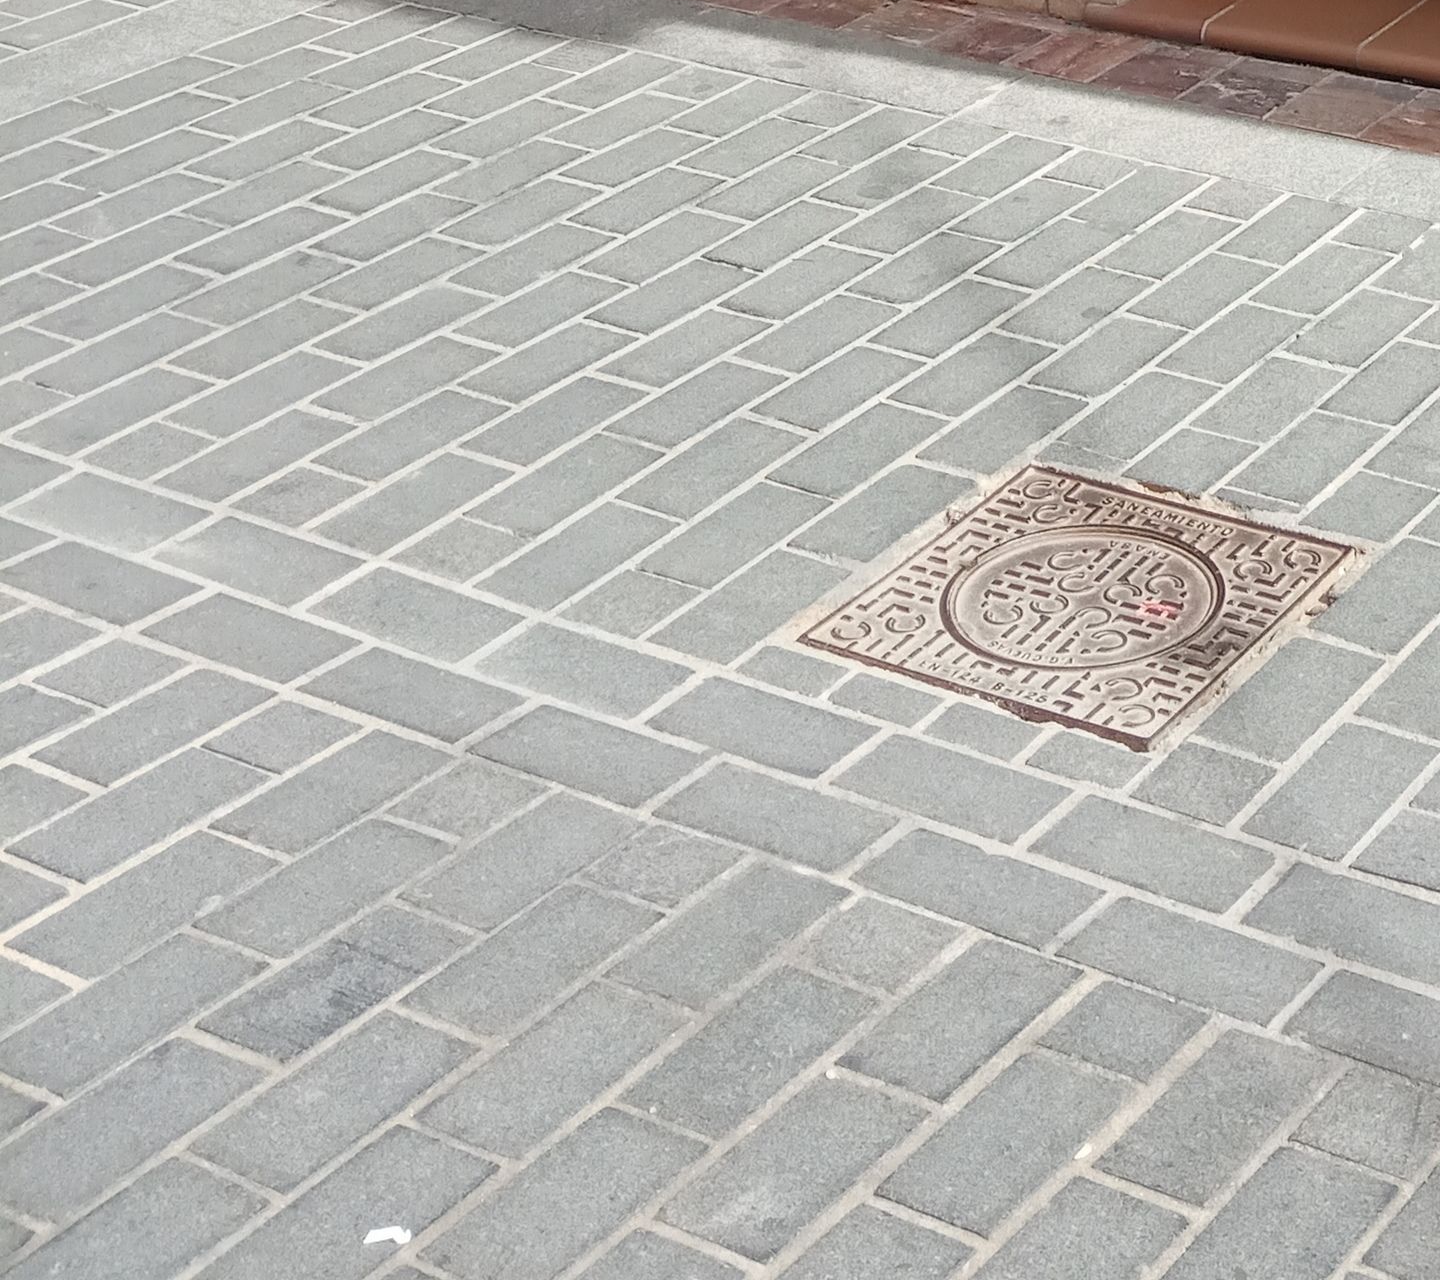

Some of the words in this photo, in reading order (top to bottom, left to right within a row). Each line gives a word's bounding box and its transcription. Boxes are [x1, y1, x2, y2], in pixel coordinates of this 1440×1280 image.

[1101, 496, 1236, 537] SANEAMIENTO
[918, 660, 982, 684] EN-124
[991, 682, 1049, 704] B-125
